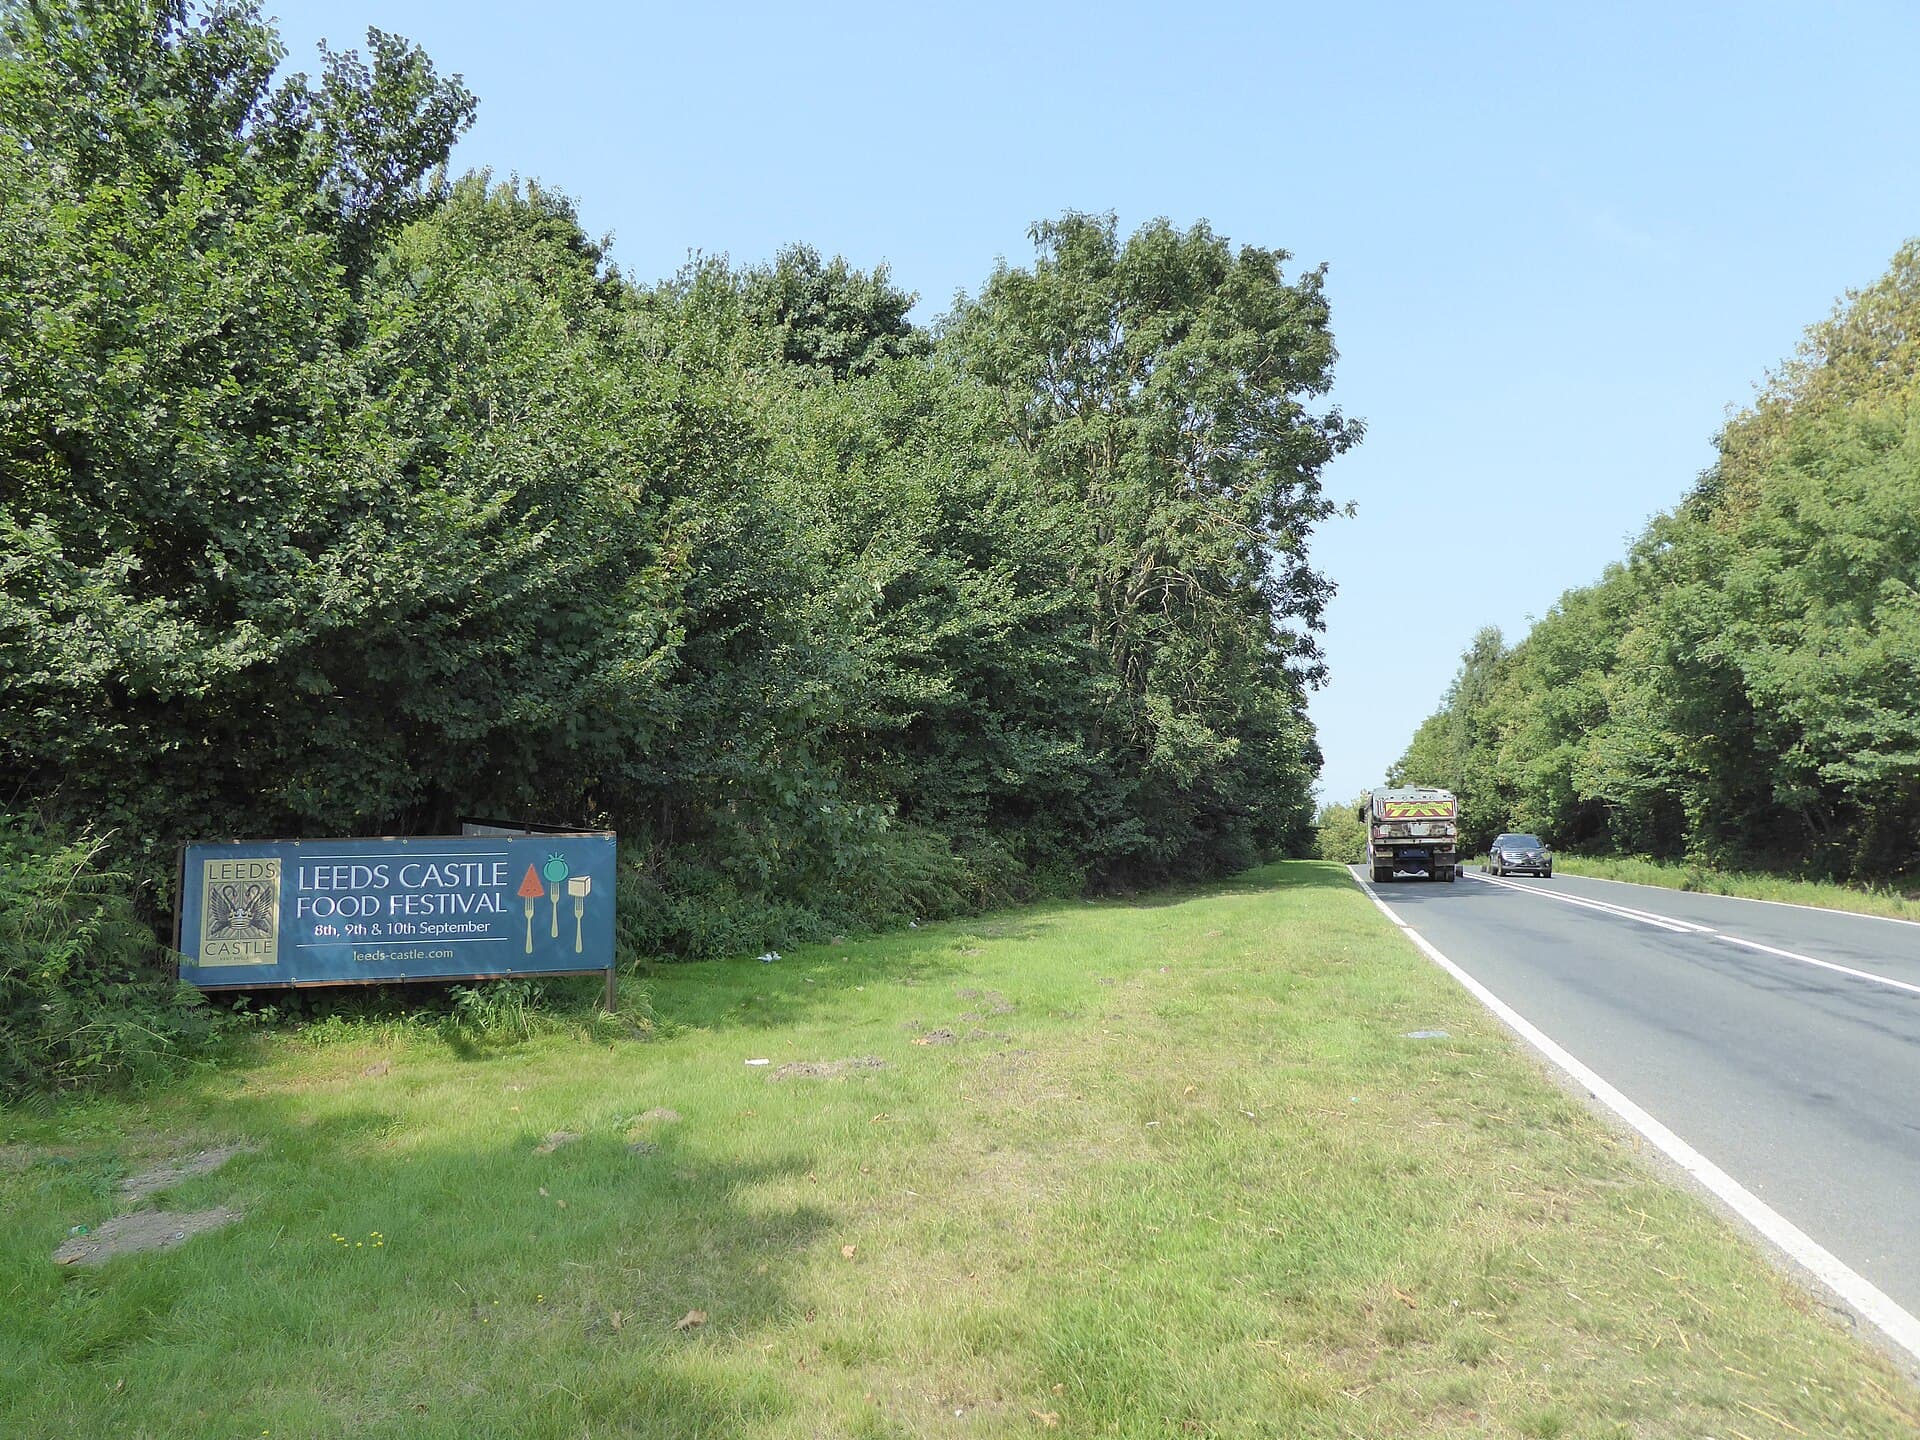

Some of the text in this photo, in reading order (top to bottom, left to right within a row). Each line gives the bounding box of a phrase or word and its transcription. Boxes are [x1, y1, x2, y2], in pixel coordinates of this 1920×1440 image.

[208, 862, 275, 880] LEEDS
[298, 861, 508, 891] LEEDS CASTLE
[296, 892, 508, 918] FOOD FESTIVAL
[314, 920, 491, 938] 8th, 9th & 10th September
[204, 940, 273, 956] CASTLE
[353, 949, 454, 962] leeds-castle.com
